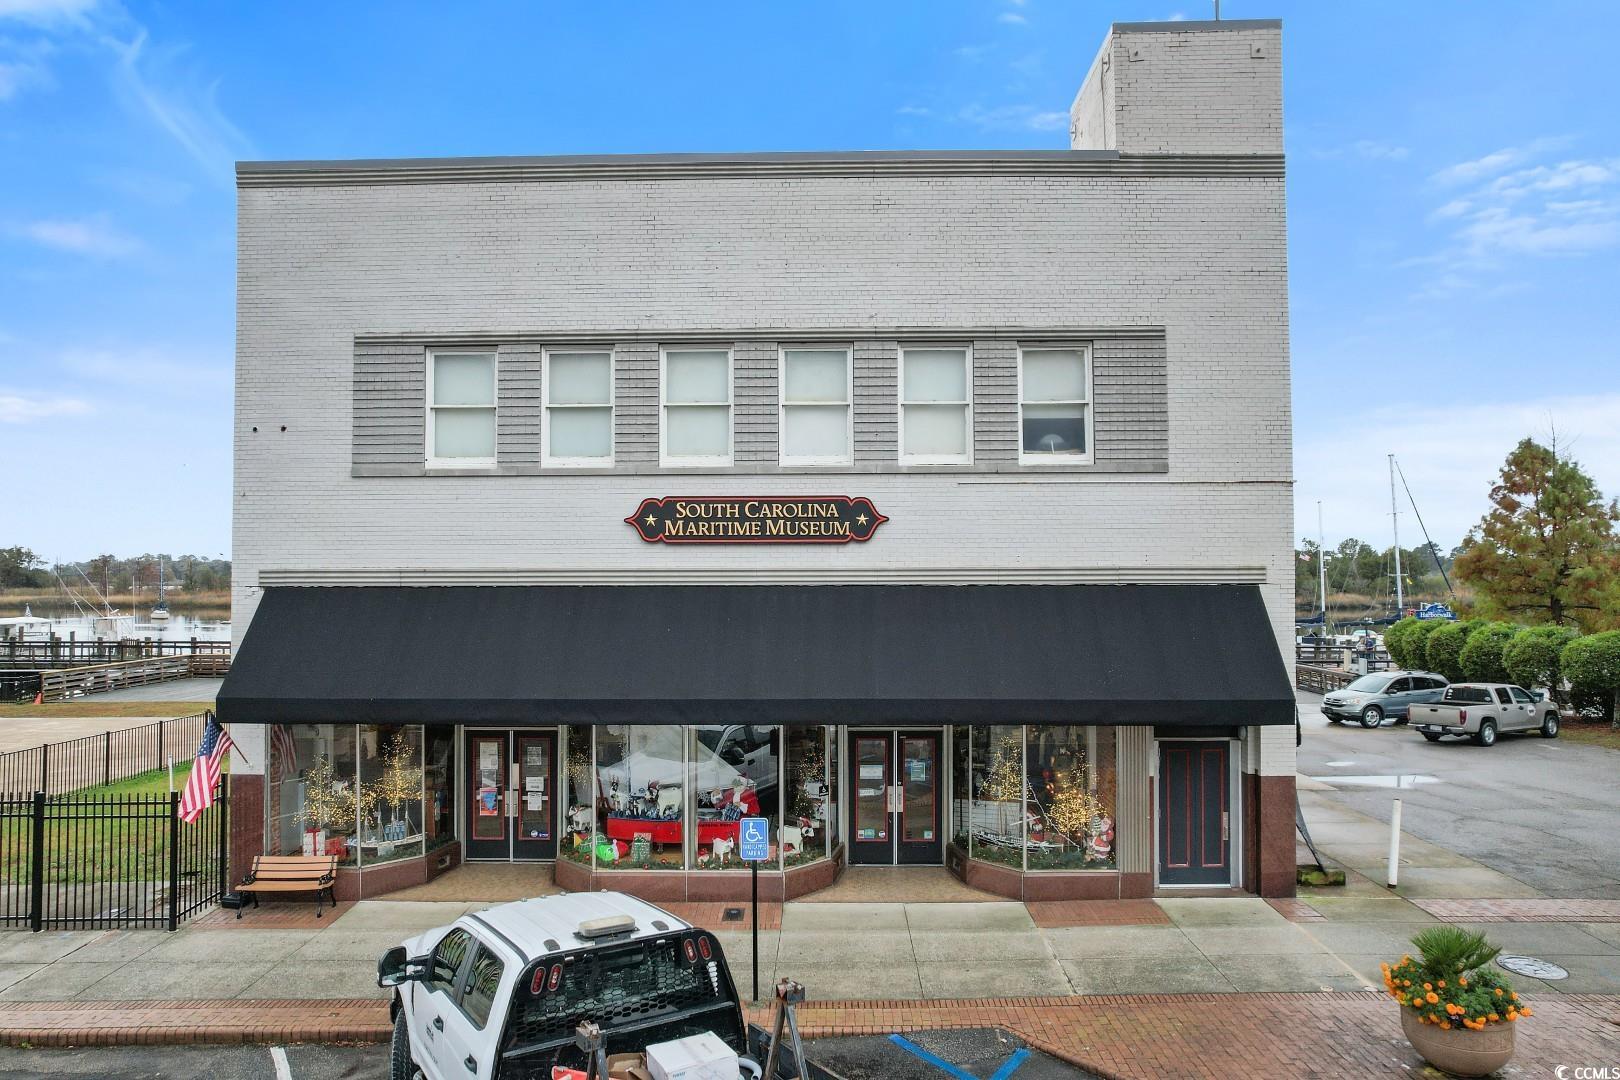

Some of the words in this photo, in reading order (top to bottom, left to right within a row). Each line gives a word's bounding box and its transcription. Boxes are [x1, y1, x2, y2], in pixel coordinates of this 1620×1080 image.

[676, 501, 740, 518] SOUTH
[744, 501, 839, 518] CAROLINA
[664, 519, 762, 536] MARITIME
[765, 519, 851, 536] MUSEUM
